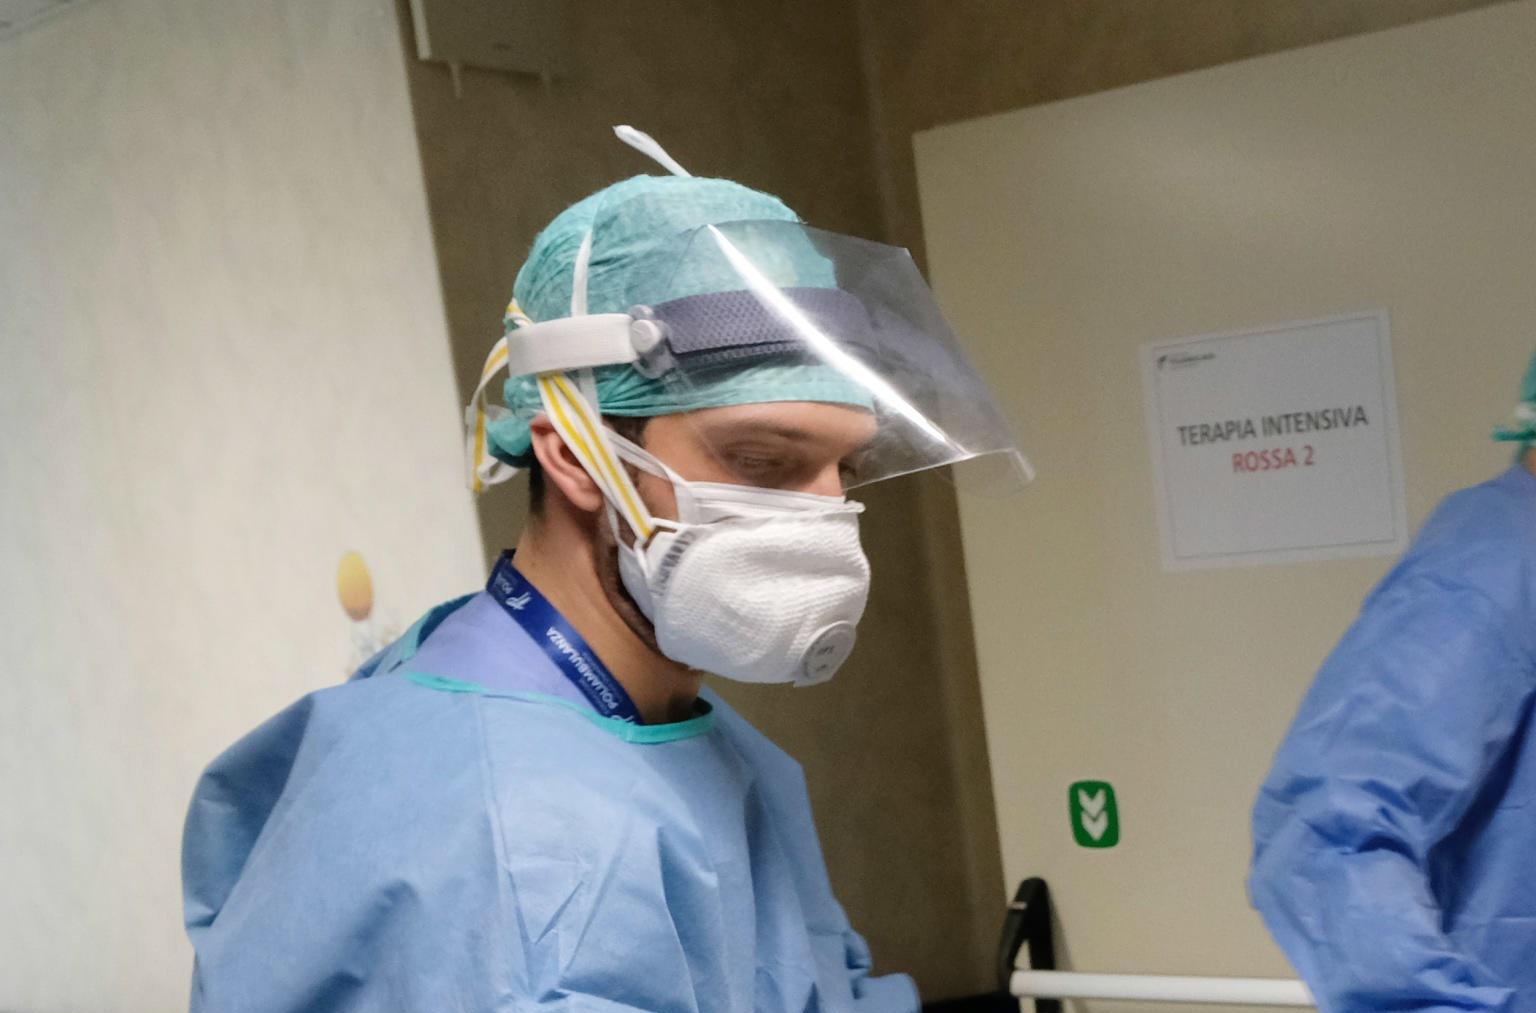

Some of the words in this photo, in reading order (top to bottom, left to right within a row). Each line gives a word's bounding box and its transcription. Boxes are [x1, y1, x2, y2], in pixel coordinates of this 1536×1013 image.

[1177, 419, 1256, 446] TERAPIA
[1262, 405, 1369, 437] INTENSIVA
[1232, 448, 1296, 474] ROSSA
[1304, 445, 1315, 466] 2
[546, 626, 617, 710] POLIAMBULANZA
